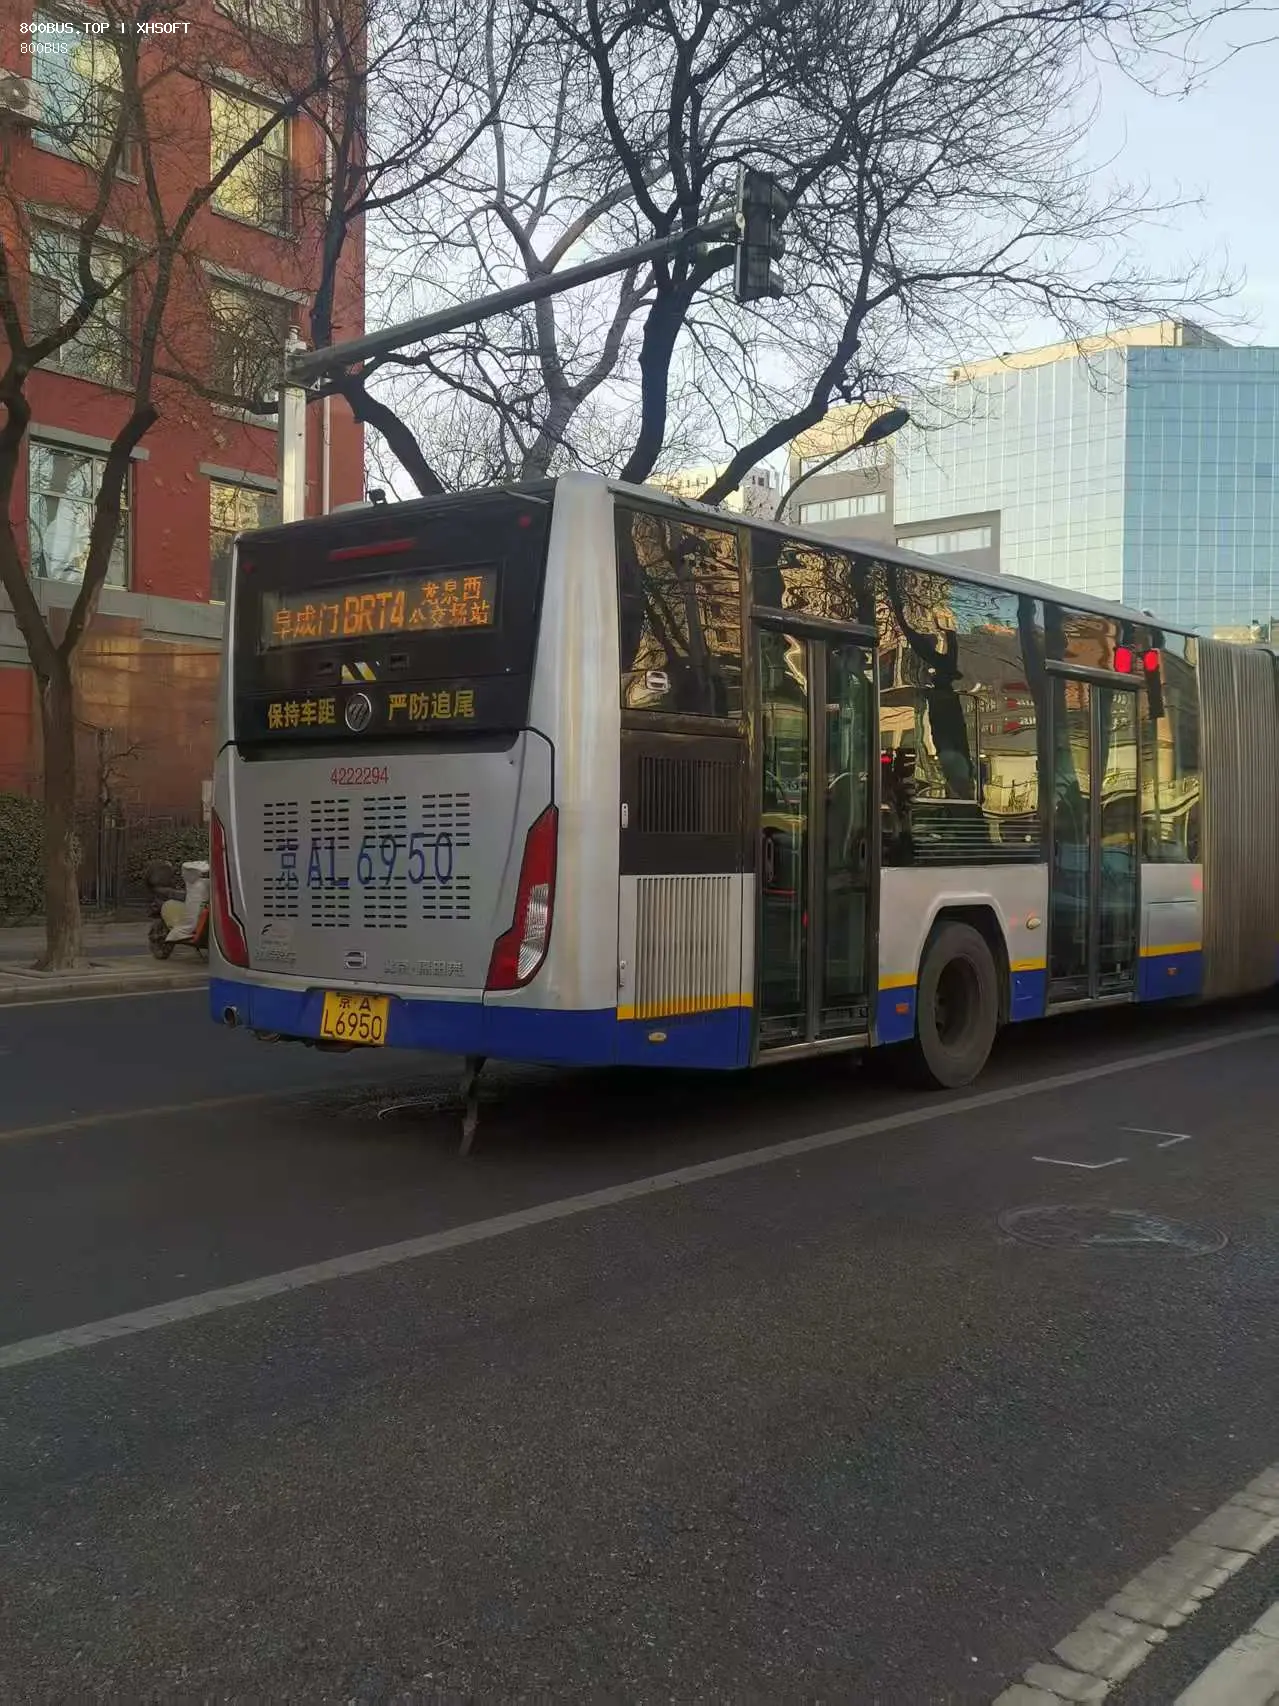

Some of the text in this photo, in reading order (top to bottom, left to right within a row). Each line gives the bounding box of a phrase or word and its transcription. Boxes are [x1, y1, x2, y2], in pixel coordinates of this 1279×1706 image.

[343, 591, 406, 634] BRT4
[267, 690, 475, 729] 保持车距 严防追尾
[330, 766, 389, 785] 4222294
[357, 832, 453, 886] 6950
[323, 1008, 383, 1040] L6950
